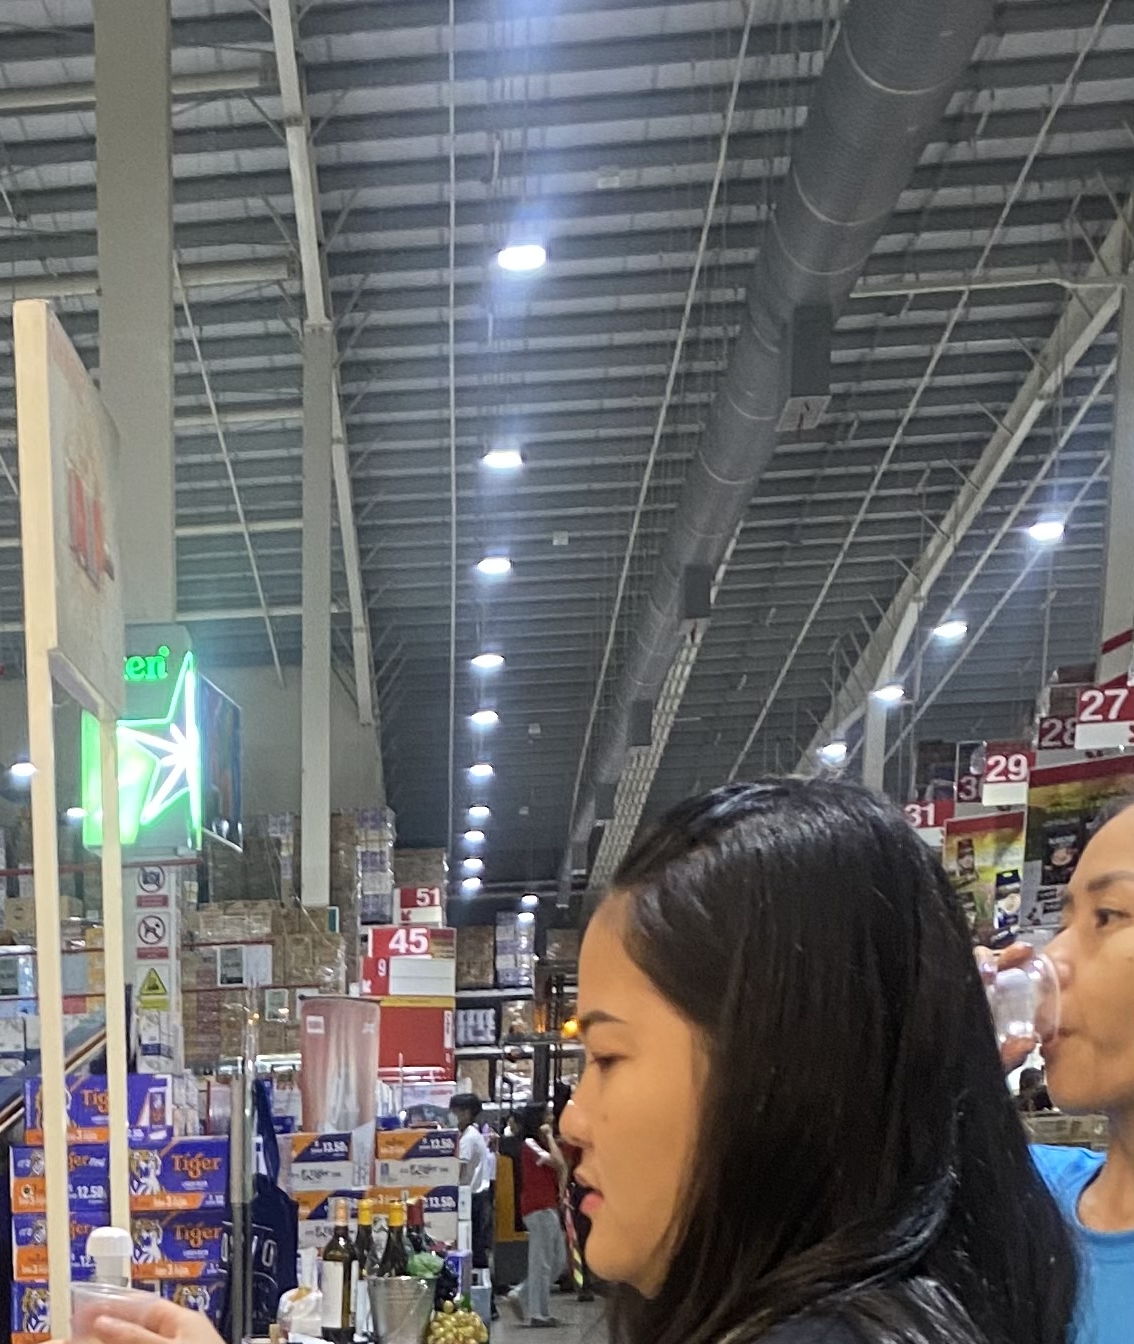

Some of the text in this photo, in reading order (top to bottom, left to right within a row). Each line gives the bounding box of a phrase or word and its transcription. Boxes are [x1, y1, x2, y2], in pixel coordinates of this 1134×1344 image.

[1080, 688, 1128, 722] 27
[985, 753, 1028, 782] 29
[958, 775, 979, 800] 3
[905, 803, 935, 826] 31
[417, 888, 440, 906] 51
[389, 928, 428, 953] 45
[378, 963, 386, 977] 9
[81, 1088, 108, 1114] Tig
[171, 1152, 222, 1179] Tiger
[174, 1222, 222, 1248] Tiger
